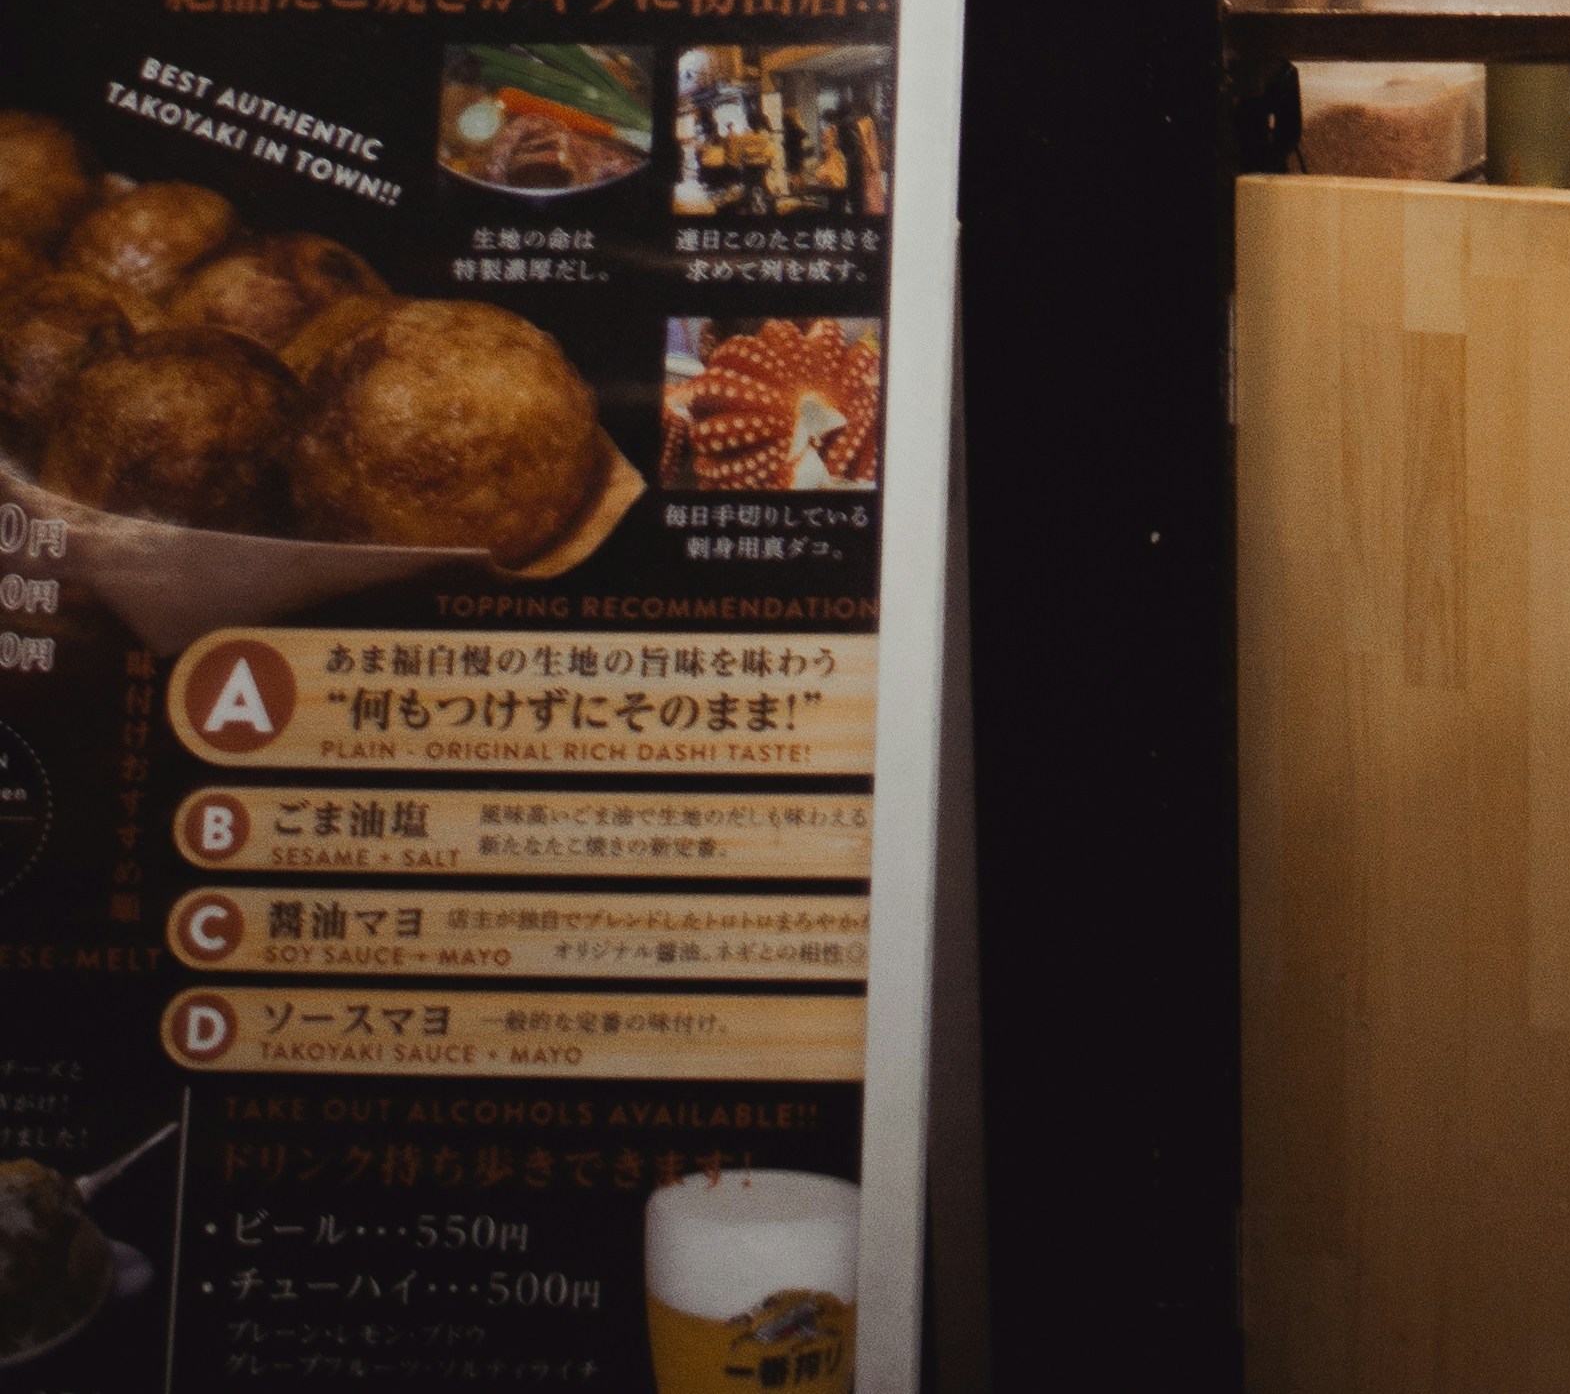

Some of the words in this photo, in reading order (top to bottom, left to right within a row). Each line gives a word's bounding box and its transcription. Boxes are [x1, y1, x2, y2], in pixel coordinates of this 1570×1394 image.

[139, 57, 213, 98] BEST
[215, 87, 384, 161] AUTHENTIC
[105, 81, 248, 151] TAKOYAKI
[252, 135, 289, 164] IN
[294, 149, 402, 207] TOWN!!
[436, 594, 569, 618] TOPPING
[196, 651, 282, 742] A
[320, 739, 397, 761] PLAIN
[426, 741, 556, 764] ORIGINAL
[564, 742, 628, 764] RICH
[637, 742, 717, 764] DASHI
[197, 801, 241, 856] B
[272, 799, 430, 841] ごま油塩
[270, 846, 372, 868] SESAME
[400, 847, 460, 869] SALT
[183, 902, 236, 955] C
[268, 901, 424, 942] 醤油マヨ
[265, 944, 312, 967] SOY
[322, 945, 402, 968] SAUCE
[436, 947, 513, 969] MAYO
[181, 1001, 232, 1055] D
[263, 1004, 452, 1038] ソースマヨ
[260, 1042, 383, 1064] TAKOYAKI
[394, 1044, 475, 1065] SAUCE
[510, 1045, 584, 1066] MAYO
[226, 1096, 308, 1121] TAKE
[322, 1098, 392, 1124] OUT
[407, 1099, 594, 1126] ALCOHOLS
